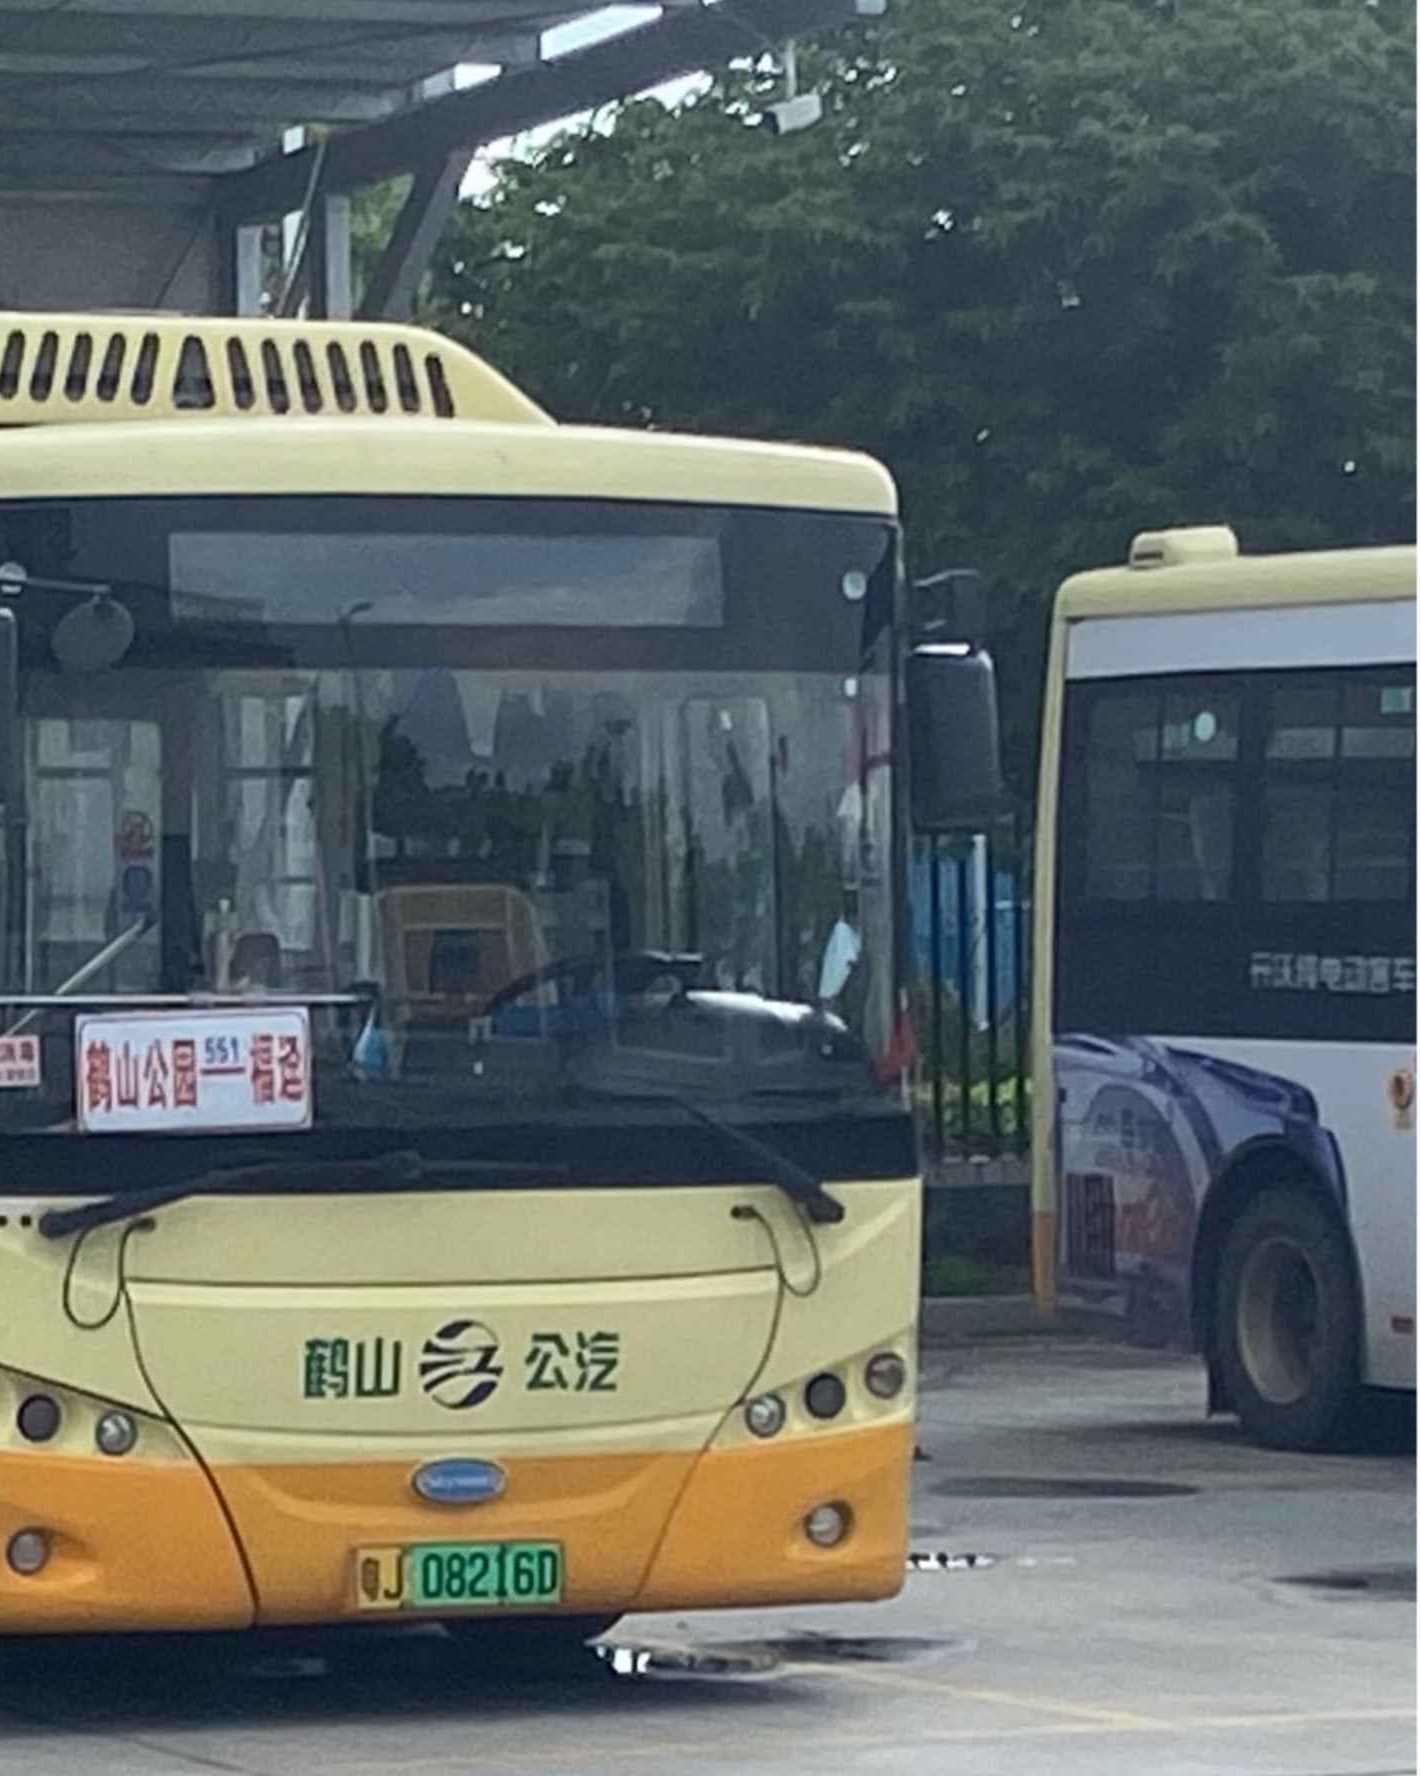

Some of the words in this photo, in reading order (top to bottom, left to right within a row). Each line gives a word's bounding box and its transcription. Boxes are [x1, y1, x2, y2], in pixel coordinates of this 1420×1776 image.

[87, 1040, 197, 1112] 鹤山公园
[204, 1037, 239, 1063] 551
[304, 1337, 401, 1398] 鹤山
[525, 1331, 619, 1392] 公汽
[421, 1551, 559, 1599] 08216D
